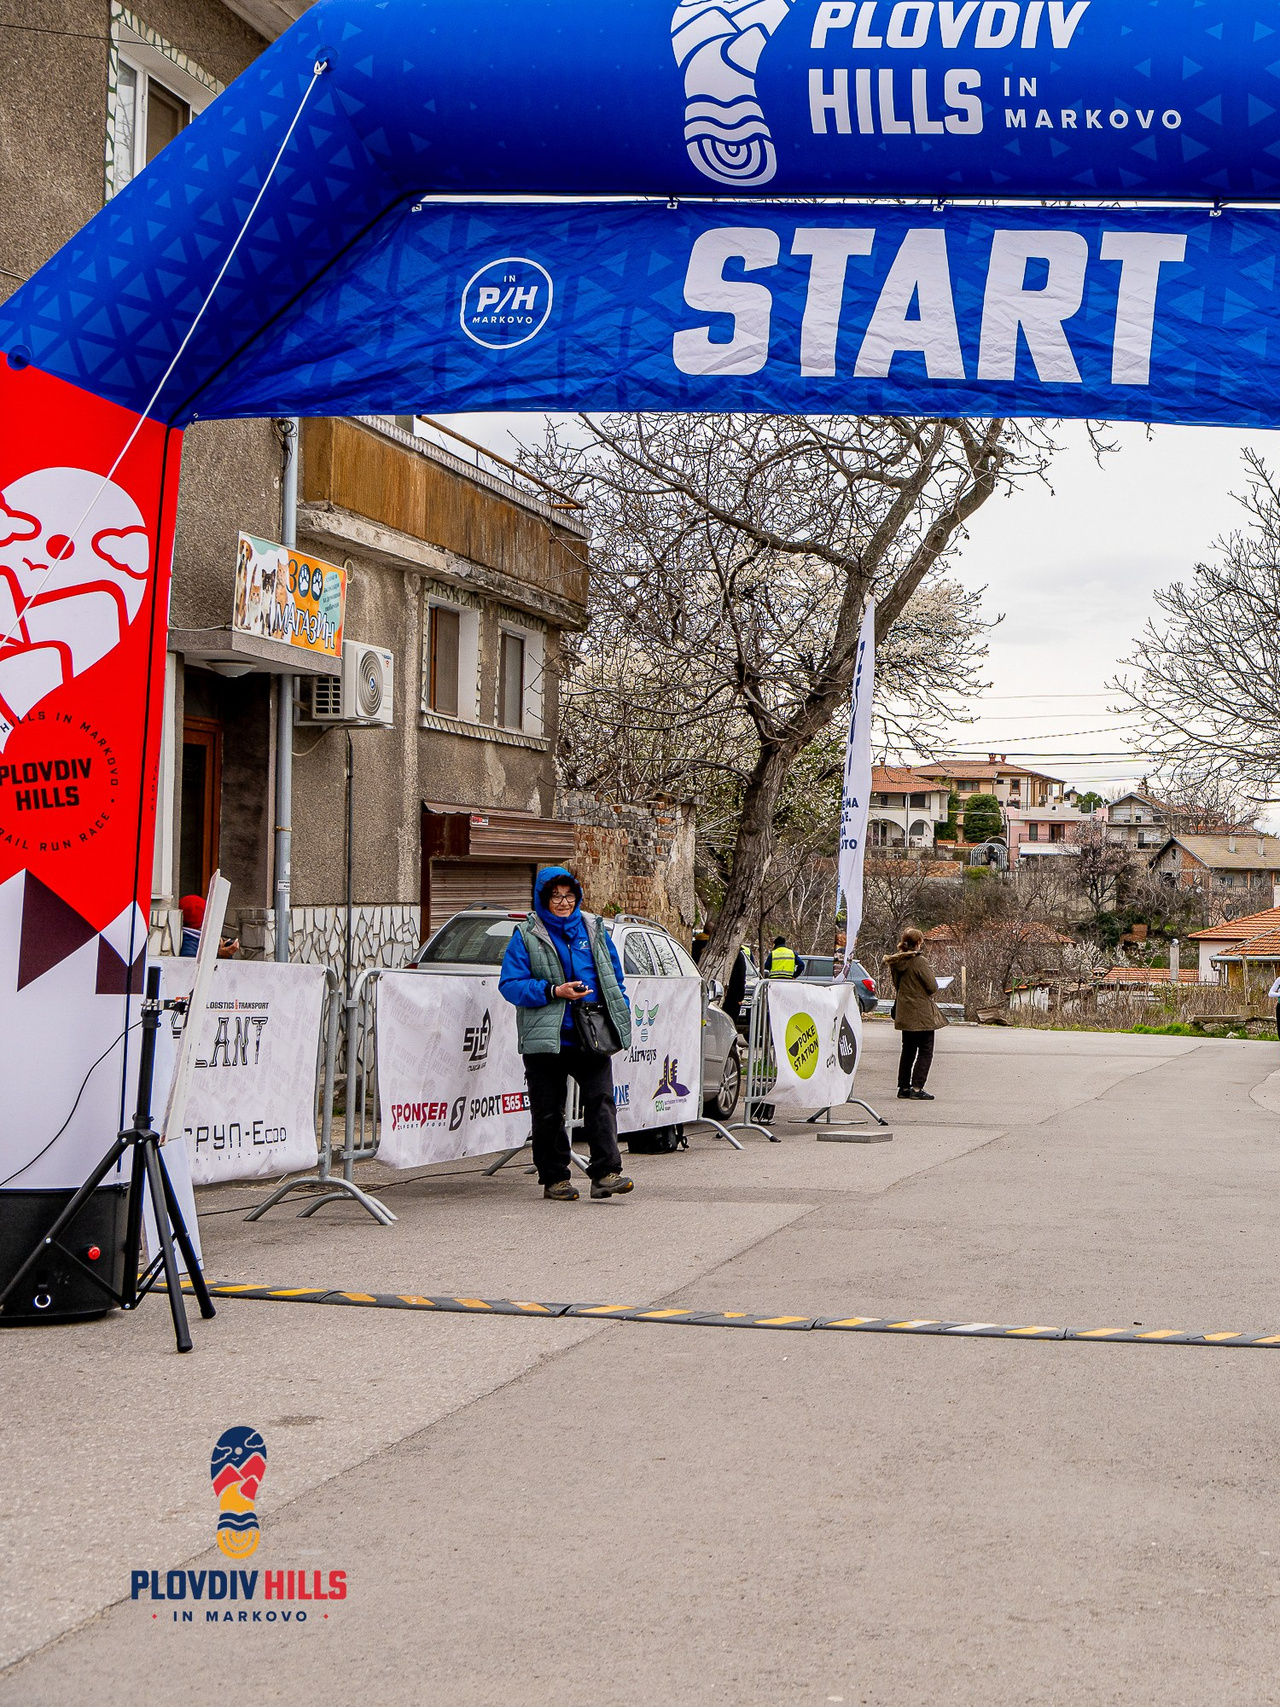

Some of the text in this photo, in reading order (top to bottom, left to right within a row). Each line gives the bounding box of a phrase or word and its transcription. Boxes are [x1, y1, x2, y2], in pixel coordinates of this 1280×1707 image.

[810, 0, 1090, 49] PLOVDIV
[808, 68, 983, 134] HILLS
[1003, 77, 1038, 98] IN
[1004, 108, 1183, 130] MARKOVO
[503, 274, 516, 283] IN
[476, 285, 539, 313] P/H
[672, 226, 1188, 386] START
[472, 316, 533, 325] MARKOVO
[274, 602, 336, 650] МАГАЗИН
[0, 711, 119, 786] HILLS IN MARKOVO
[0, 757, 92, 787] PLOVDIV
[16, 786, 80, 811] HILLS
[0, 812, 110, 851] RAIL RUN RACE
[799, 1025, 815, 1047] POKE
[793, 1038, 819, 1071] STATION
[391, 1102, 448, 1131] SPONSER
